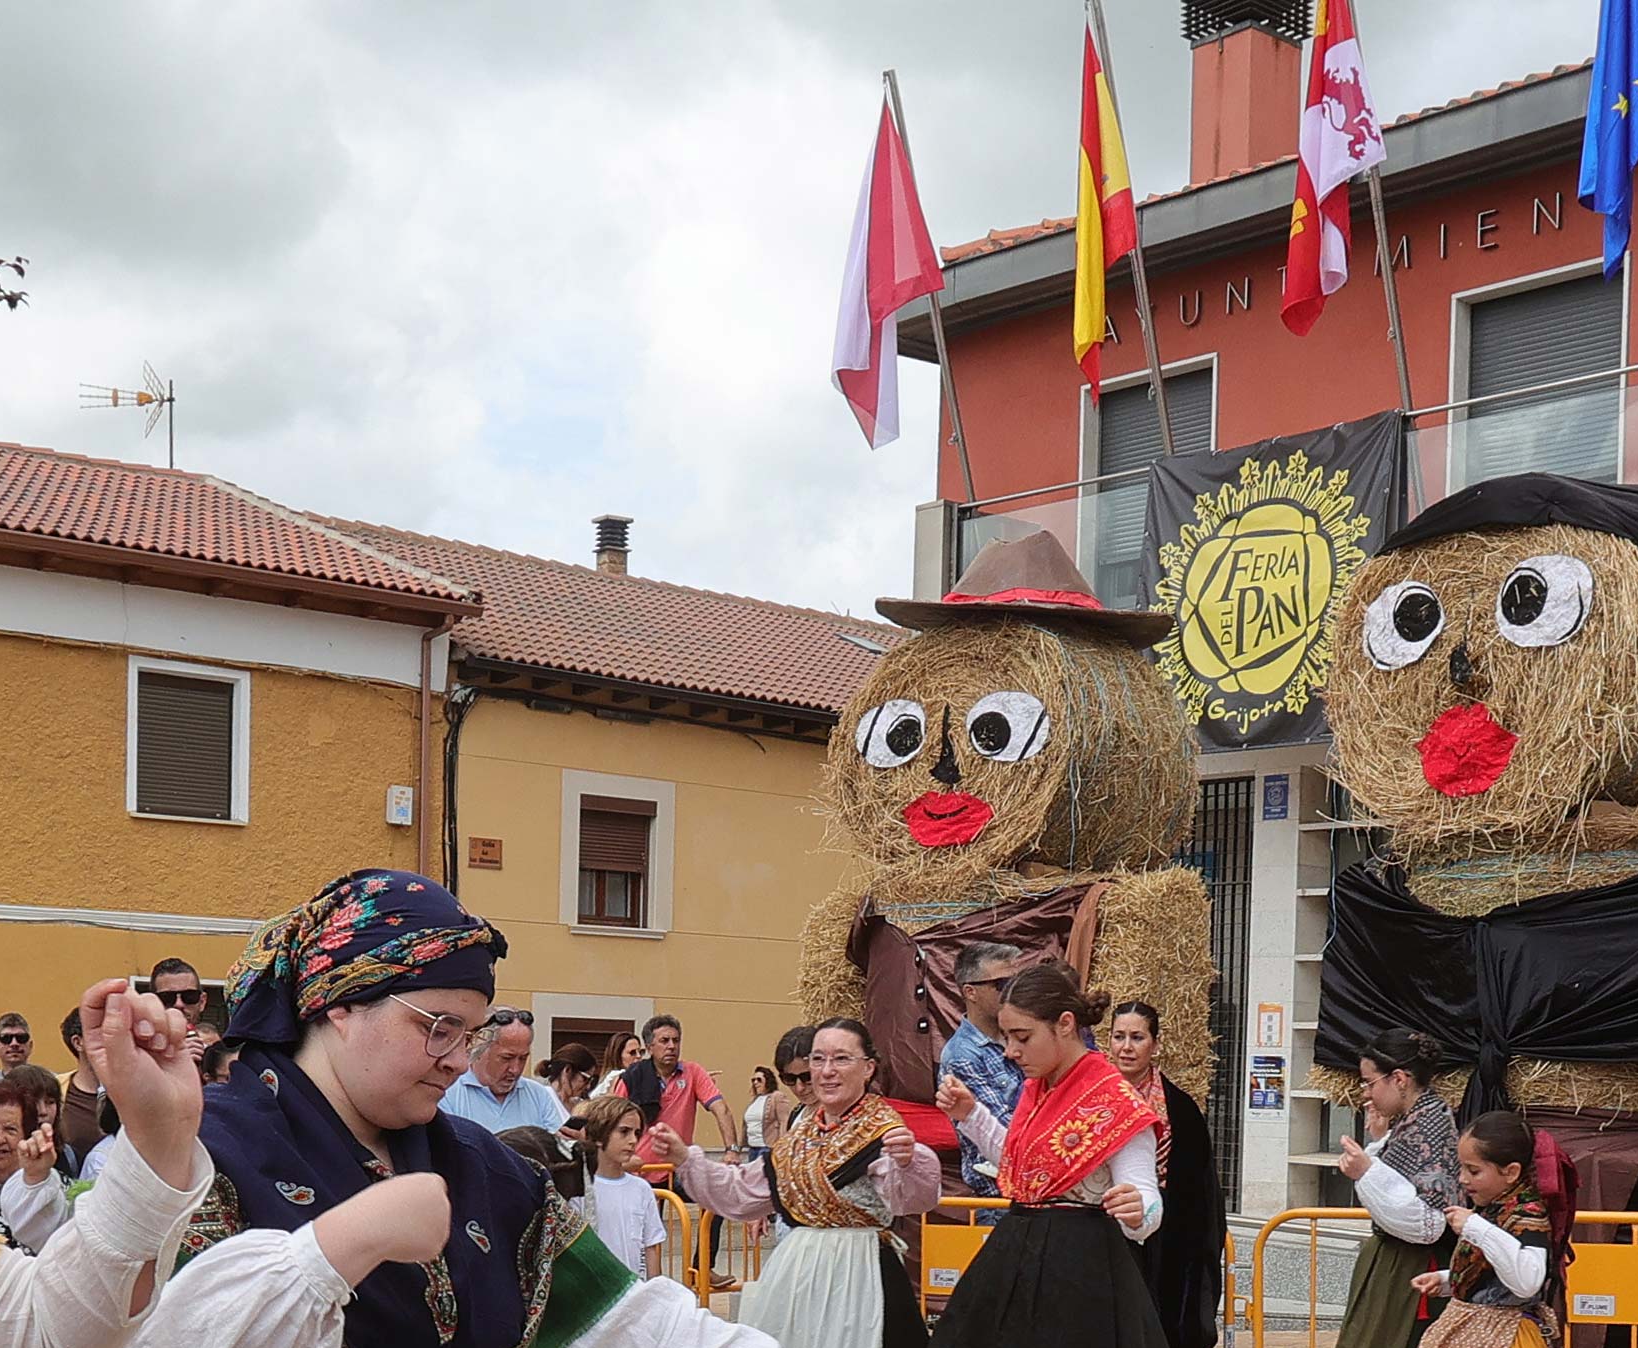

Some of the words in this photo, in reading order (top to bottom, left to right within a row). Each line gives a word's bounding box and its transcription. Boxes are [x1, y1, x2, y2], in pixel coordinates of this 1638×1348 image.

[1216, 546, 1300, 603] FERIA
[1220, 604, 1234, 646] DEL
[1232, 584, 1301, 660] PAN
[1207, 695, 1285, 735] Grijota
